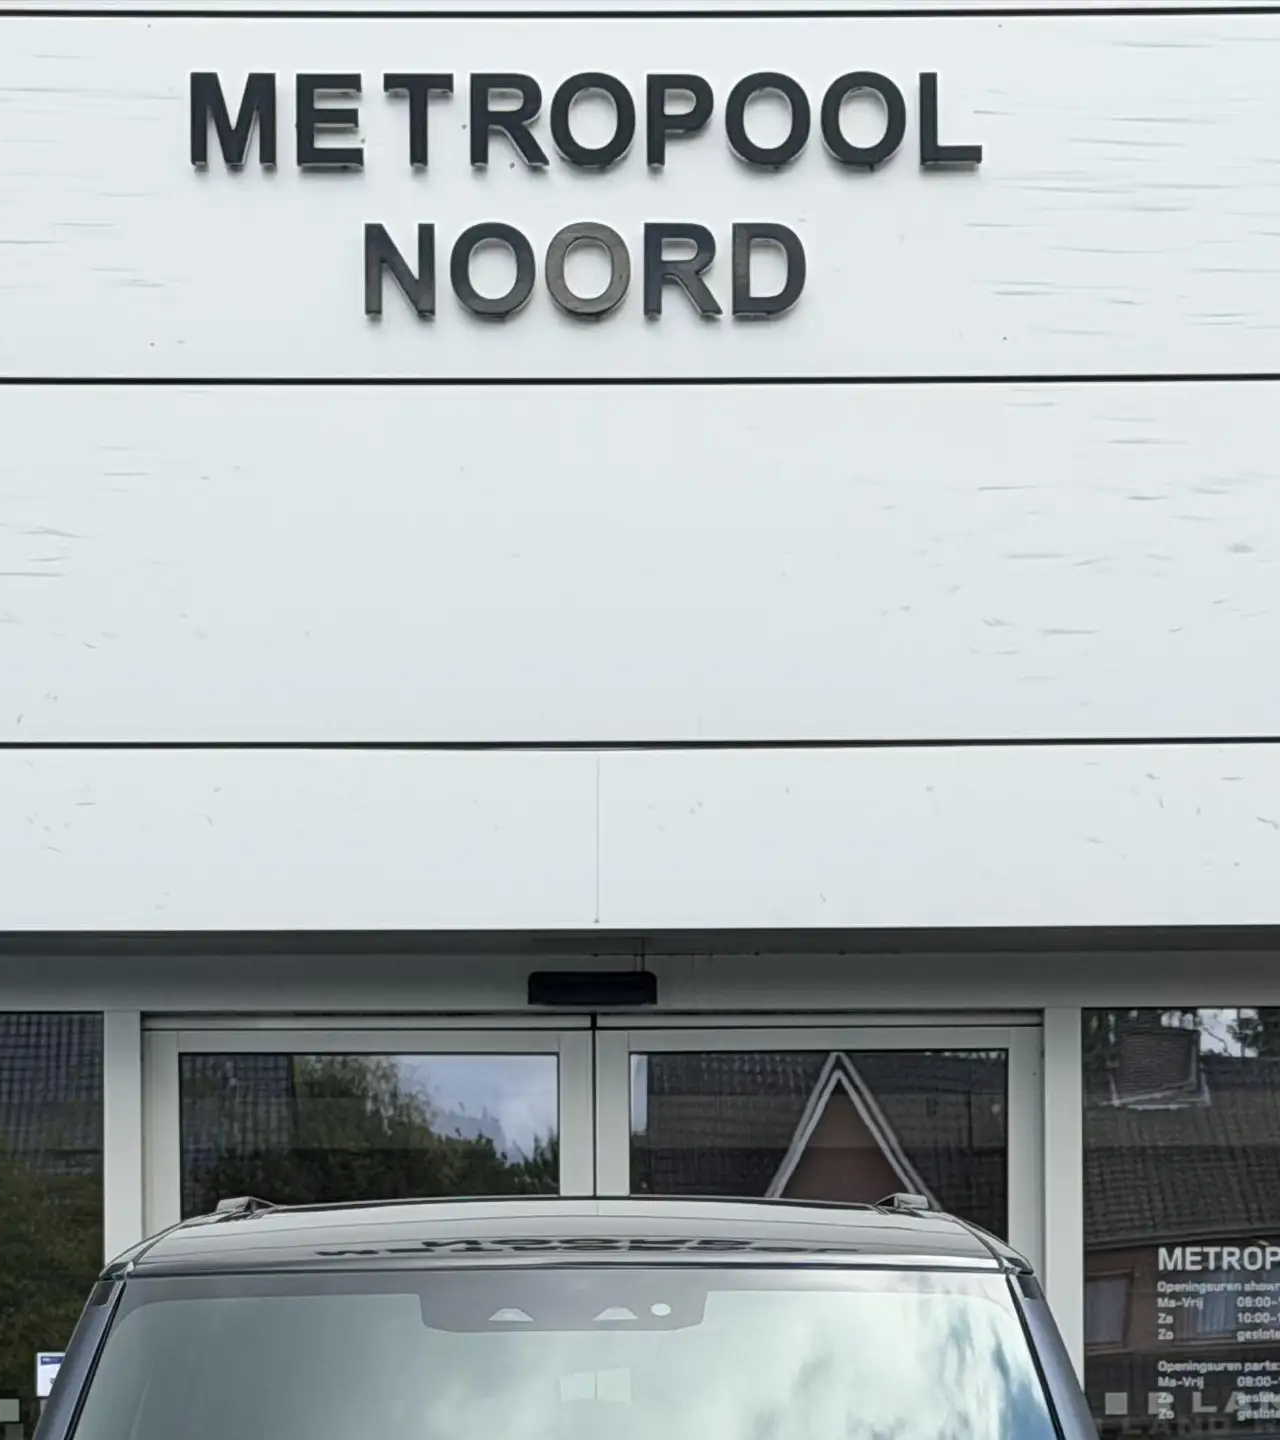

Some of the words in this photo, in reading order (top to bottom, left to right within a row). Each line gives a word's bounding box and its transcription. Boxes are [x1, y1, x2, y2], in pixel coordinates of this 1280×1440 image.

[189, 70, 983, 171] METROPOOL
[363, 220, 807, 320] NOORD
[1156, 1280, 1242, 1295] Openingsuren
[1156, 1296, 1204, 1311] Ma-Vrij
[1157, 1359, 1242, 1374] Openingsuren
[1244, 1360, 1280, 1374] parts:
[1157, 1376, 1205, 1390] Ma-Vrij
